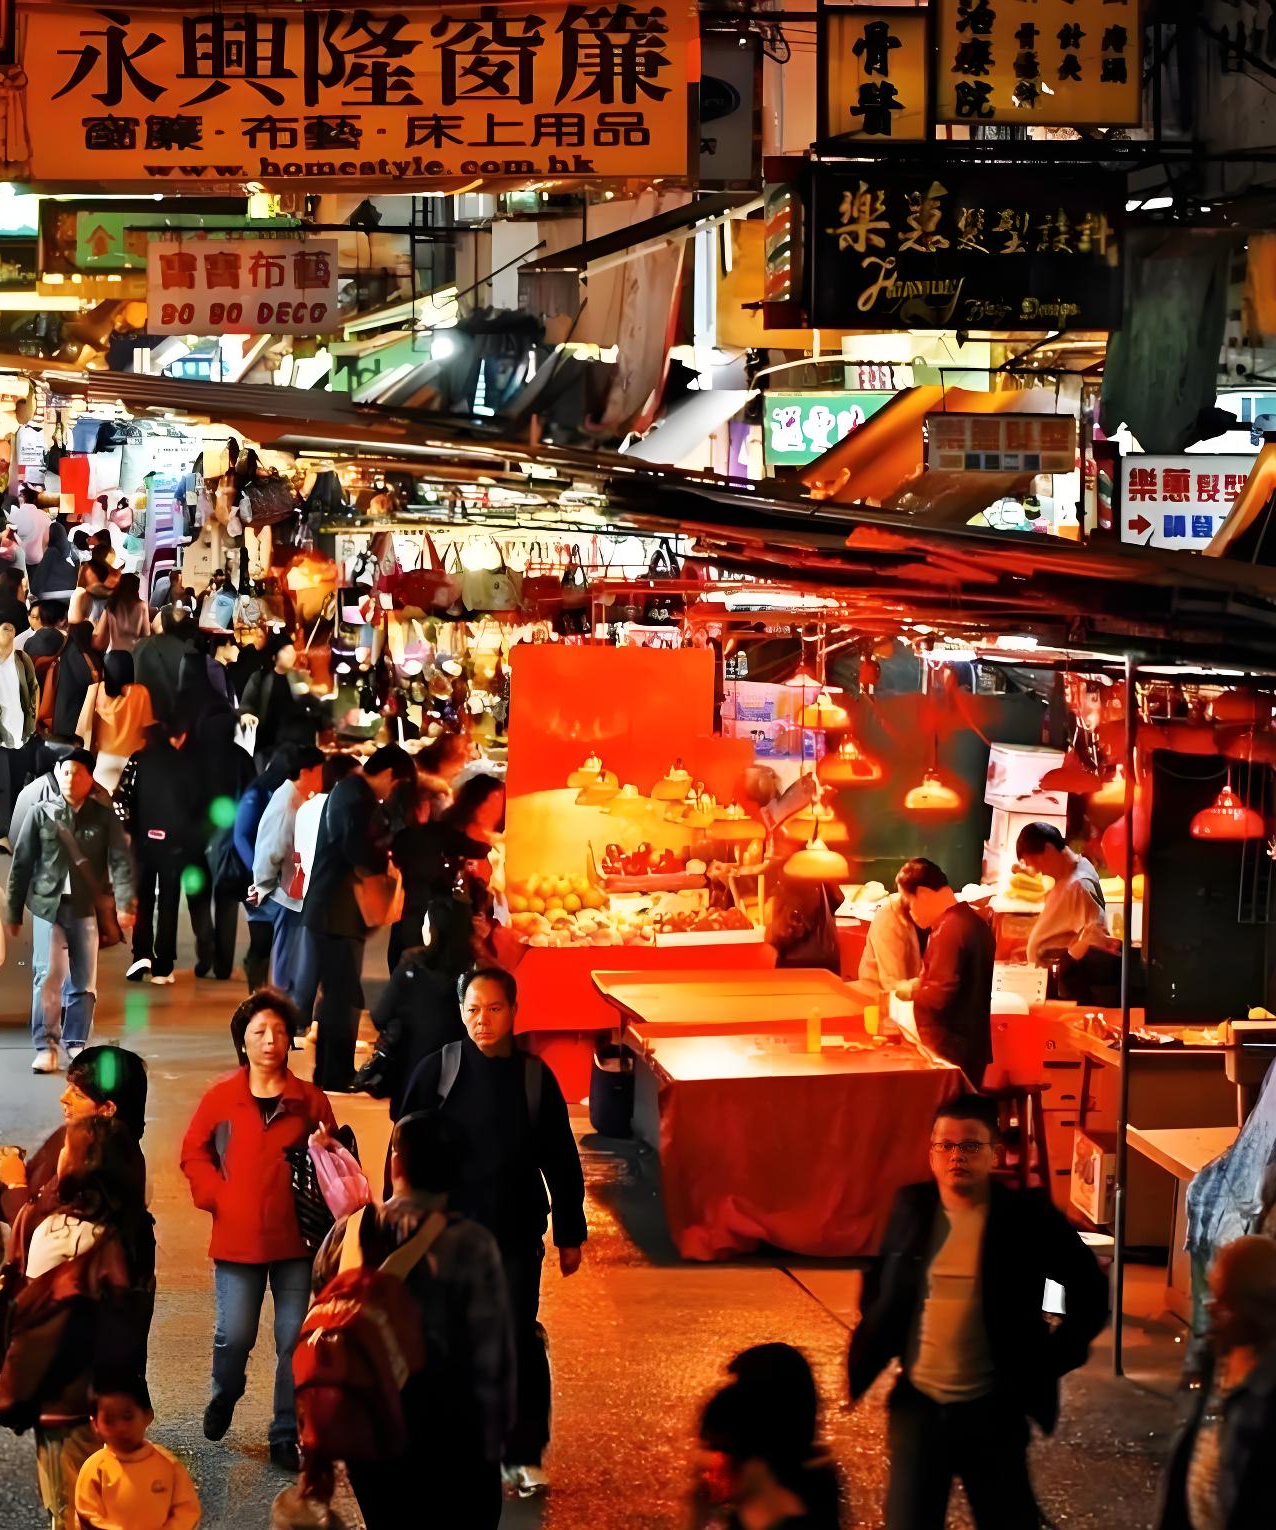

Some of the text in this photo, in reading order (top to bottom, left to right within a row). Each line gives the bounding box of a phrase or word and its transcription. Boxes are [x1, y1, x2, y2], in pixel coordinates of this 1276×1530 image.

[51, 4, 673, 107] 永興隆窗簾
[257, 302, 327, 325] DECO
